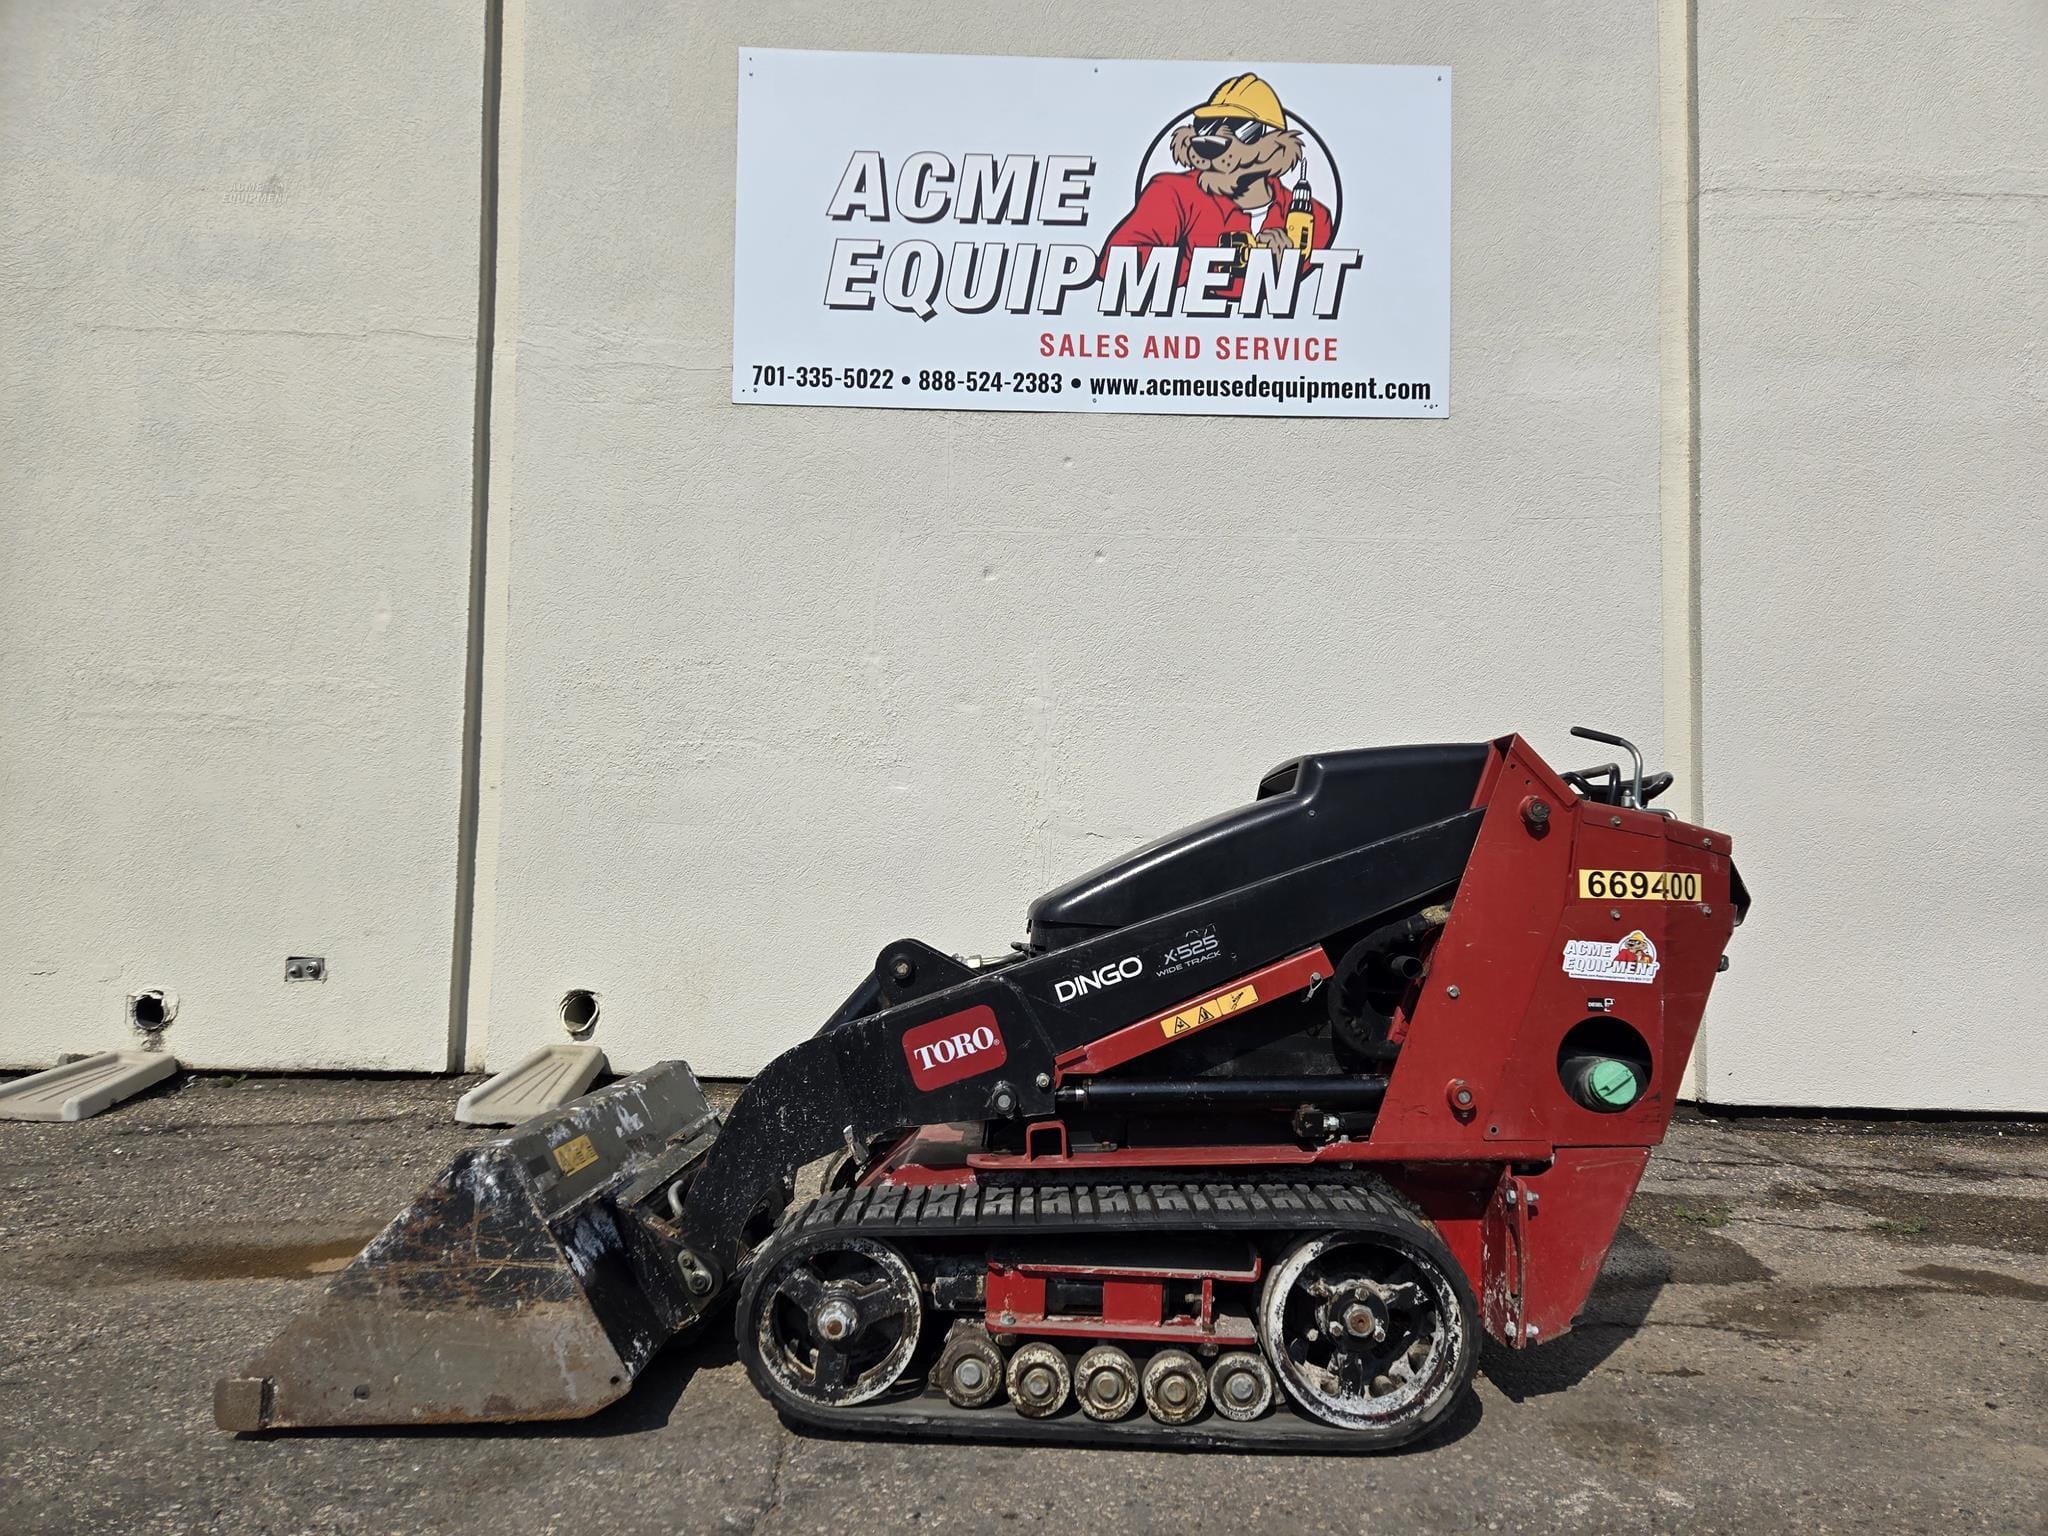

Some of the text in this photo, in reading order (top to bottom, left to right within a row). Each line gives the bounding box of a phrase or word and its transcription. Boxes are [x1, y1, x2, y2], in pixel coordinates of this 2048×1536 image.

[826, 151, 1096, 226] ACME
[824, 238, 1363, 322] EQUIPMENT
[1040, 333, 1338, 362] SALES AND SERVICE
[752, 365, 1431, 403] 701-335-5022 888-524-2383 www.acmeusedequipment.com
[1588, 871, 1696, 900] 669400
[1156, 950, 1221, 977] WIDE TRACK
[1566, 941, 1613, 957] ACME
[1054, 956, 1143, 1003] DINGO
[1565, 957, 1657, 976] EQUIPMENT
[913, 1026, 994, 1071] TORO
